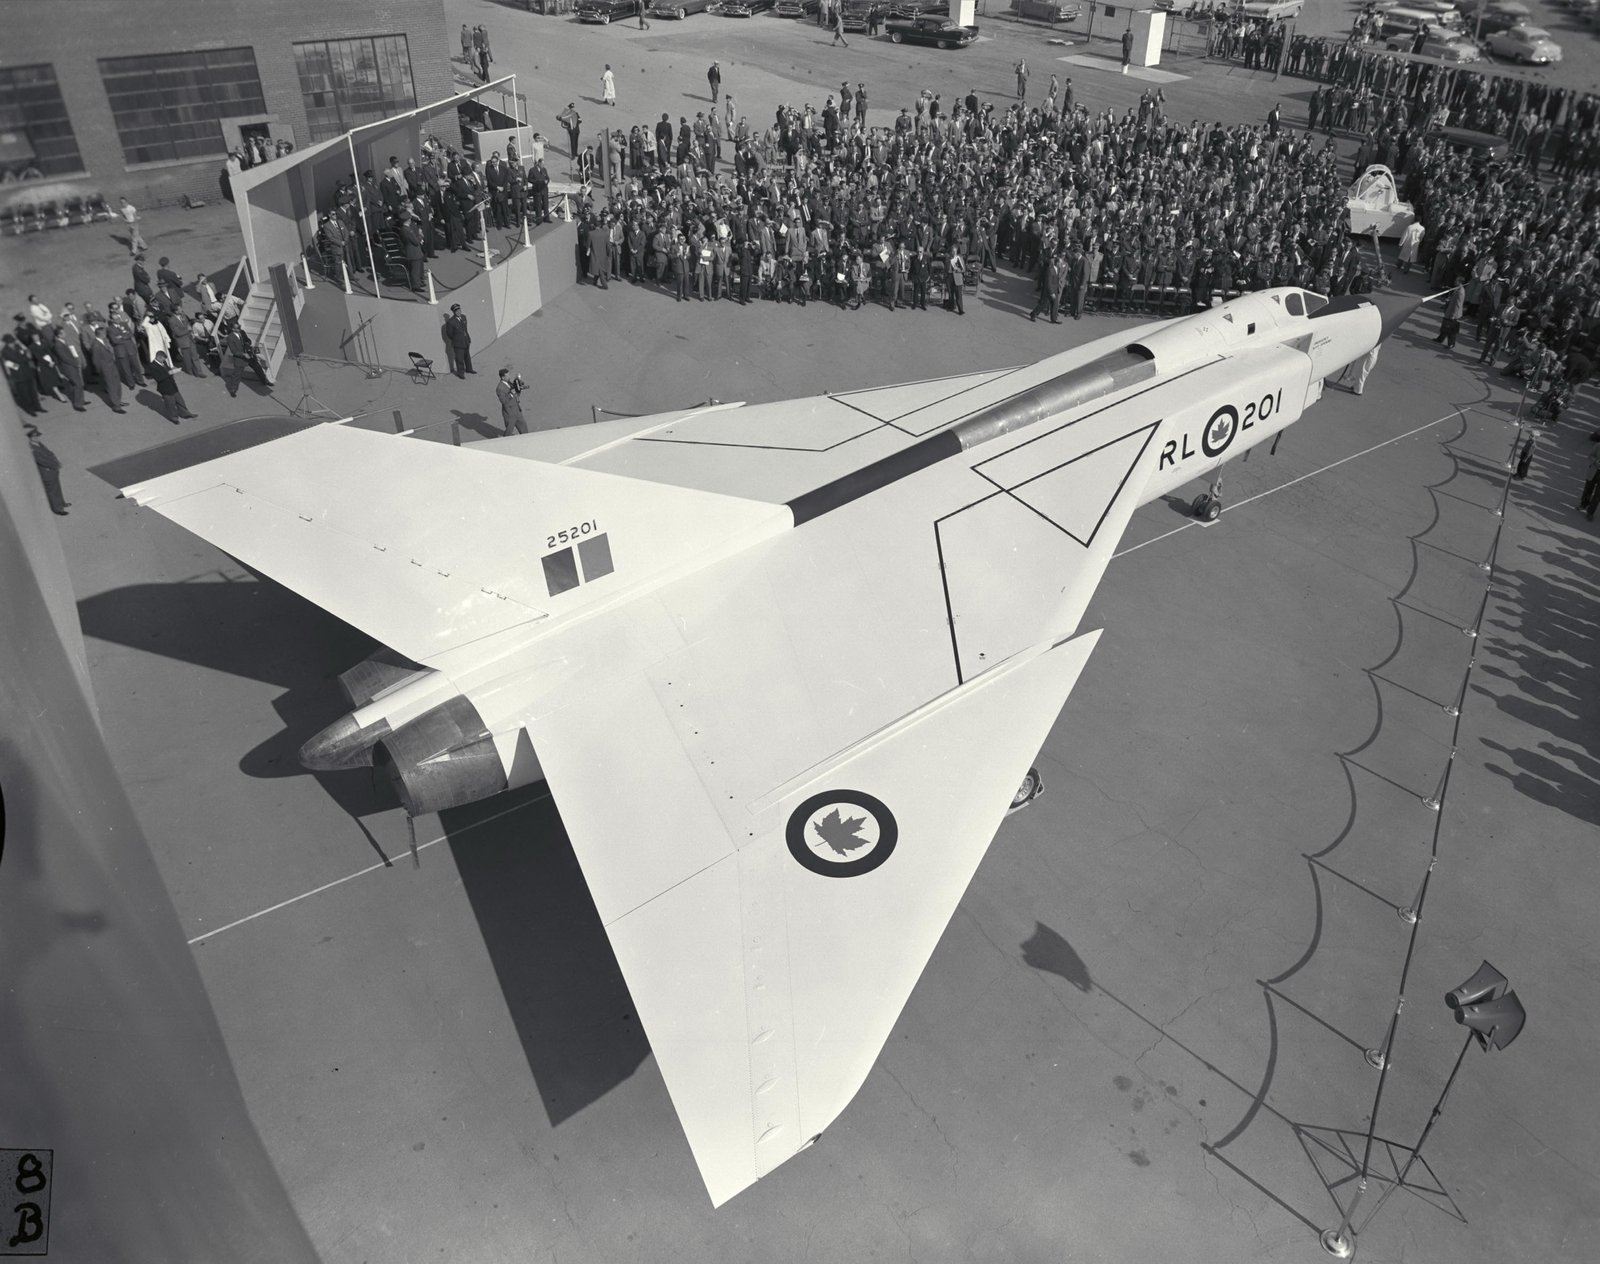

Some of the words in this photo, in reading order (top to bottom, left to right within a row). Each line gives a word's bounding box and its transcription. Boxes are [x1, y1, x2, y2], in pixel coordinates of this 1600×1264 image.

[1159, 433, 1196, 471] RL
[1241, 387, 1283, 431] 201
[546, 519, 597, 549] 25201
